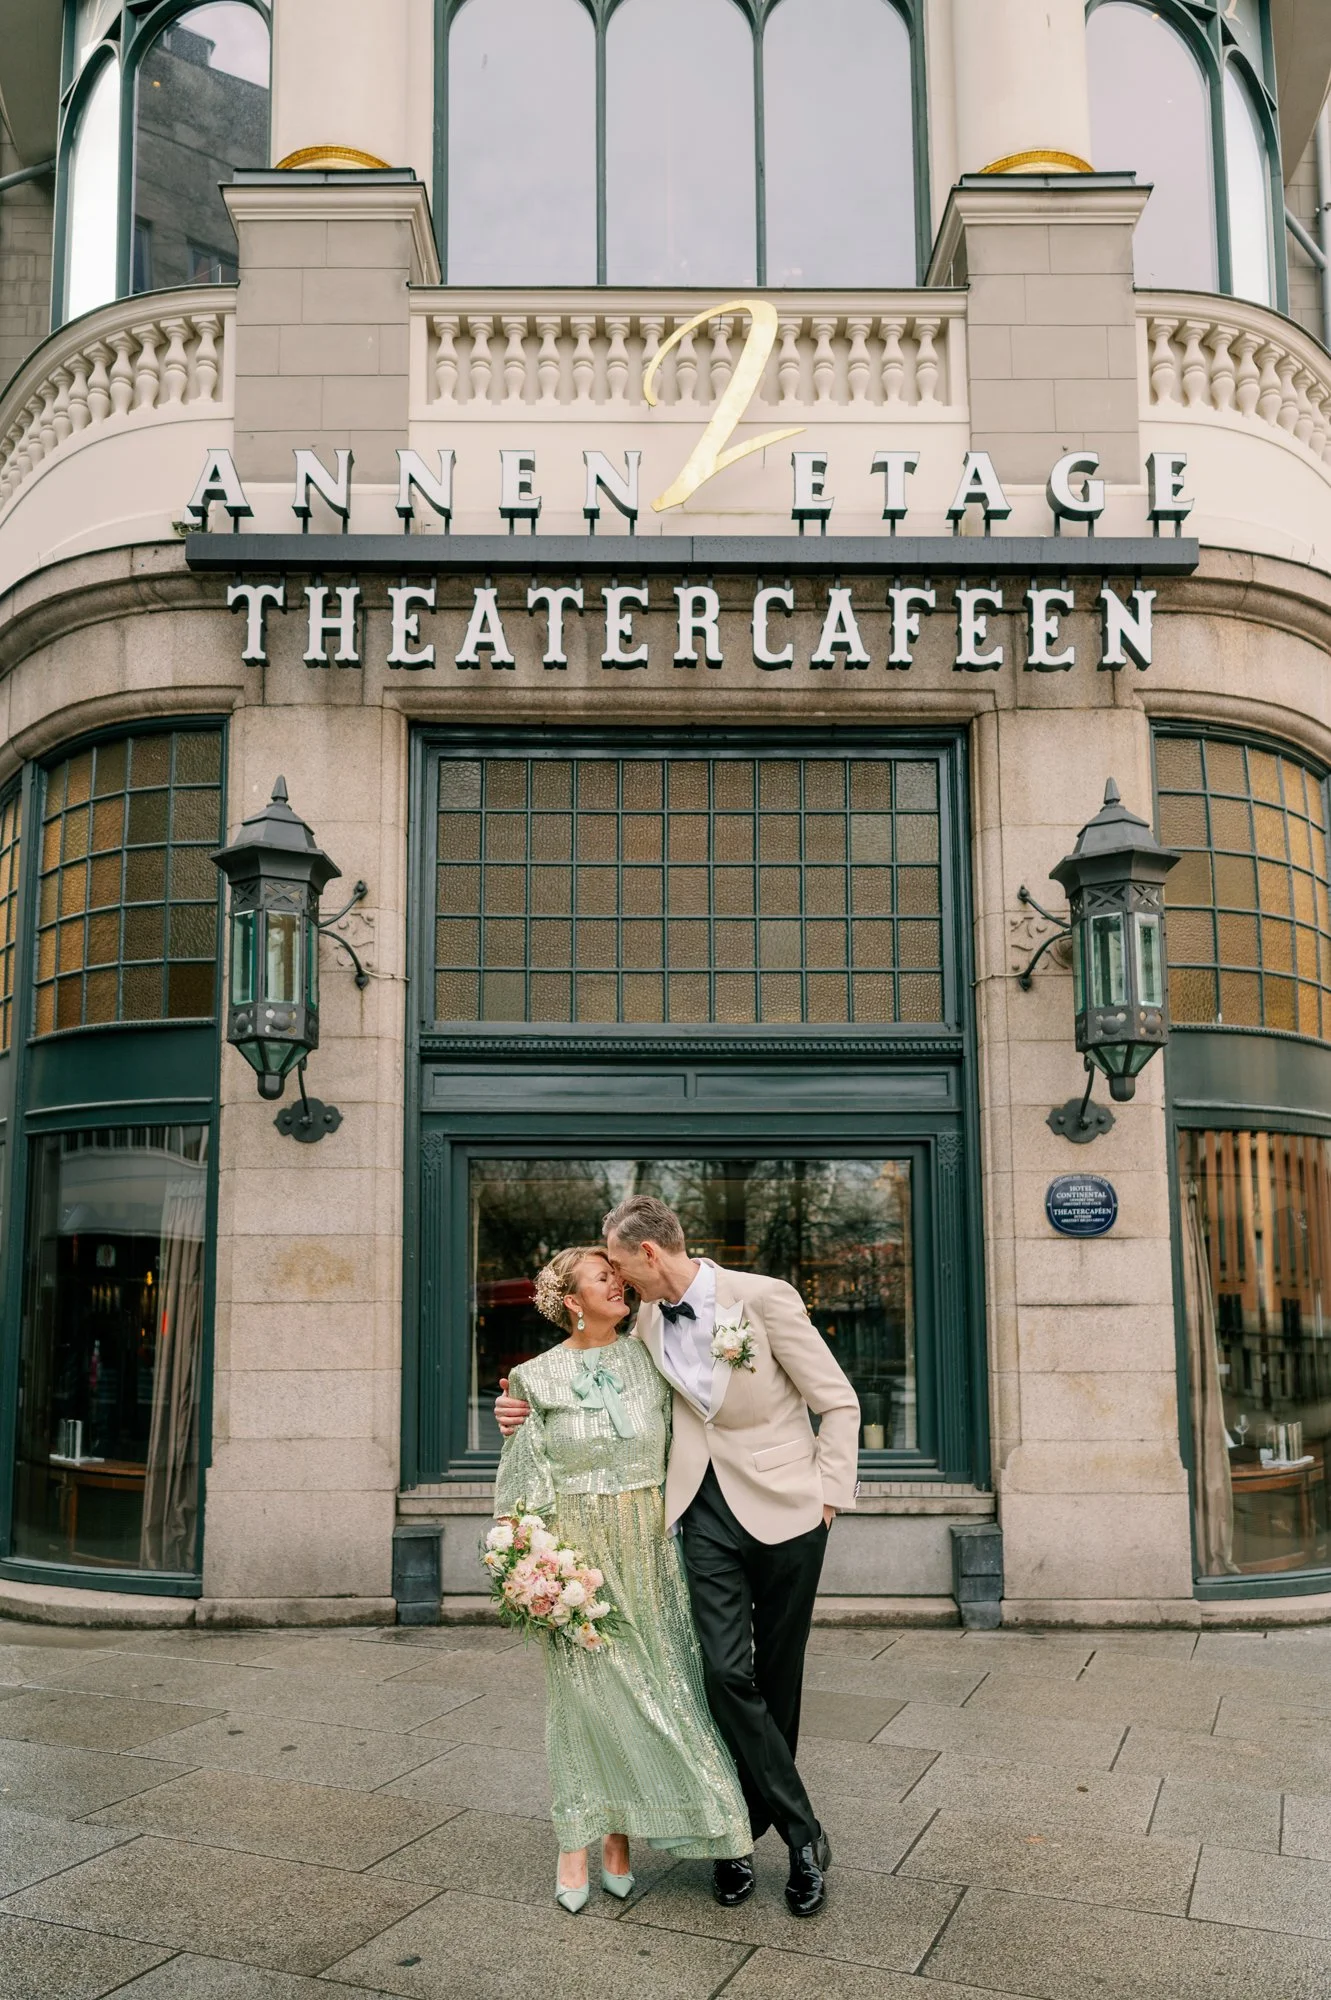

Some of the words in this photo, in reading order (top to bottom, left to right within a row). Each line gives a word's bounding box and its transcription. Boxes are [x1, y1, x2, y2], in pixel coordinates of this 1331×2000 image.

[187, 449, 642, 520] ANNEN
[643, 299, 807, 512] 2
[791, 451, 1195, 522] ETAGE
[227, 584, 1157, 671] THEATERCAFEEN
[1056, 1191, 1107, 1199] CONTINENTAL
